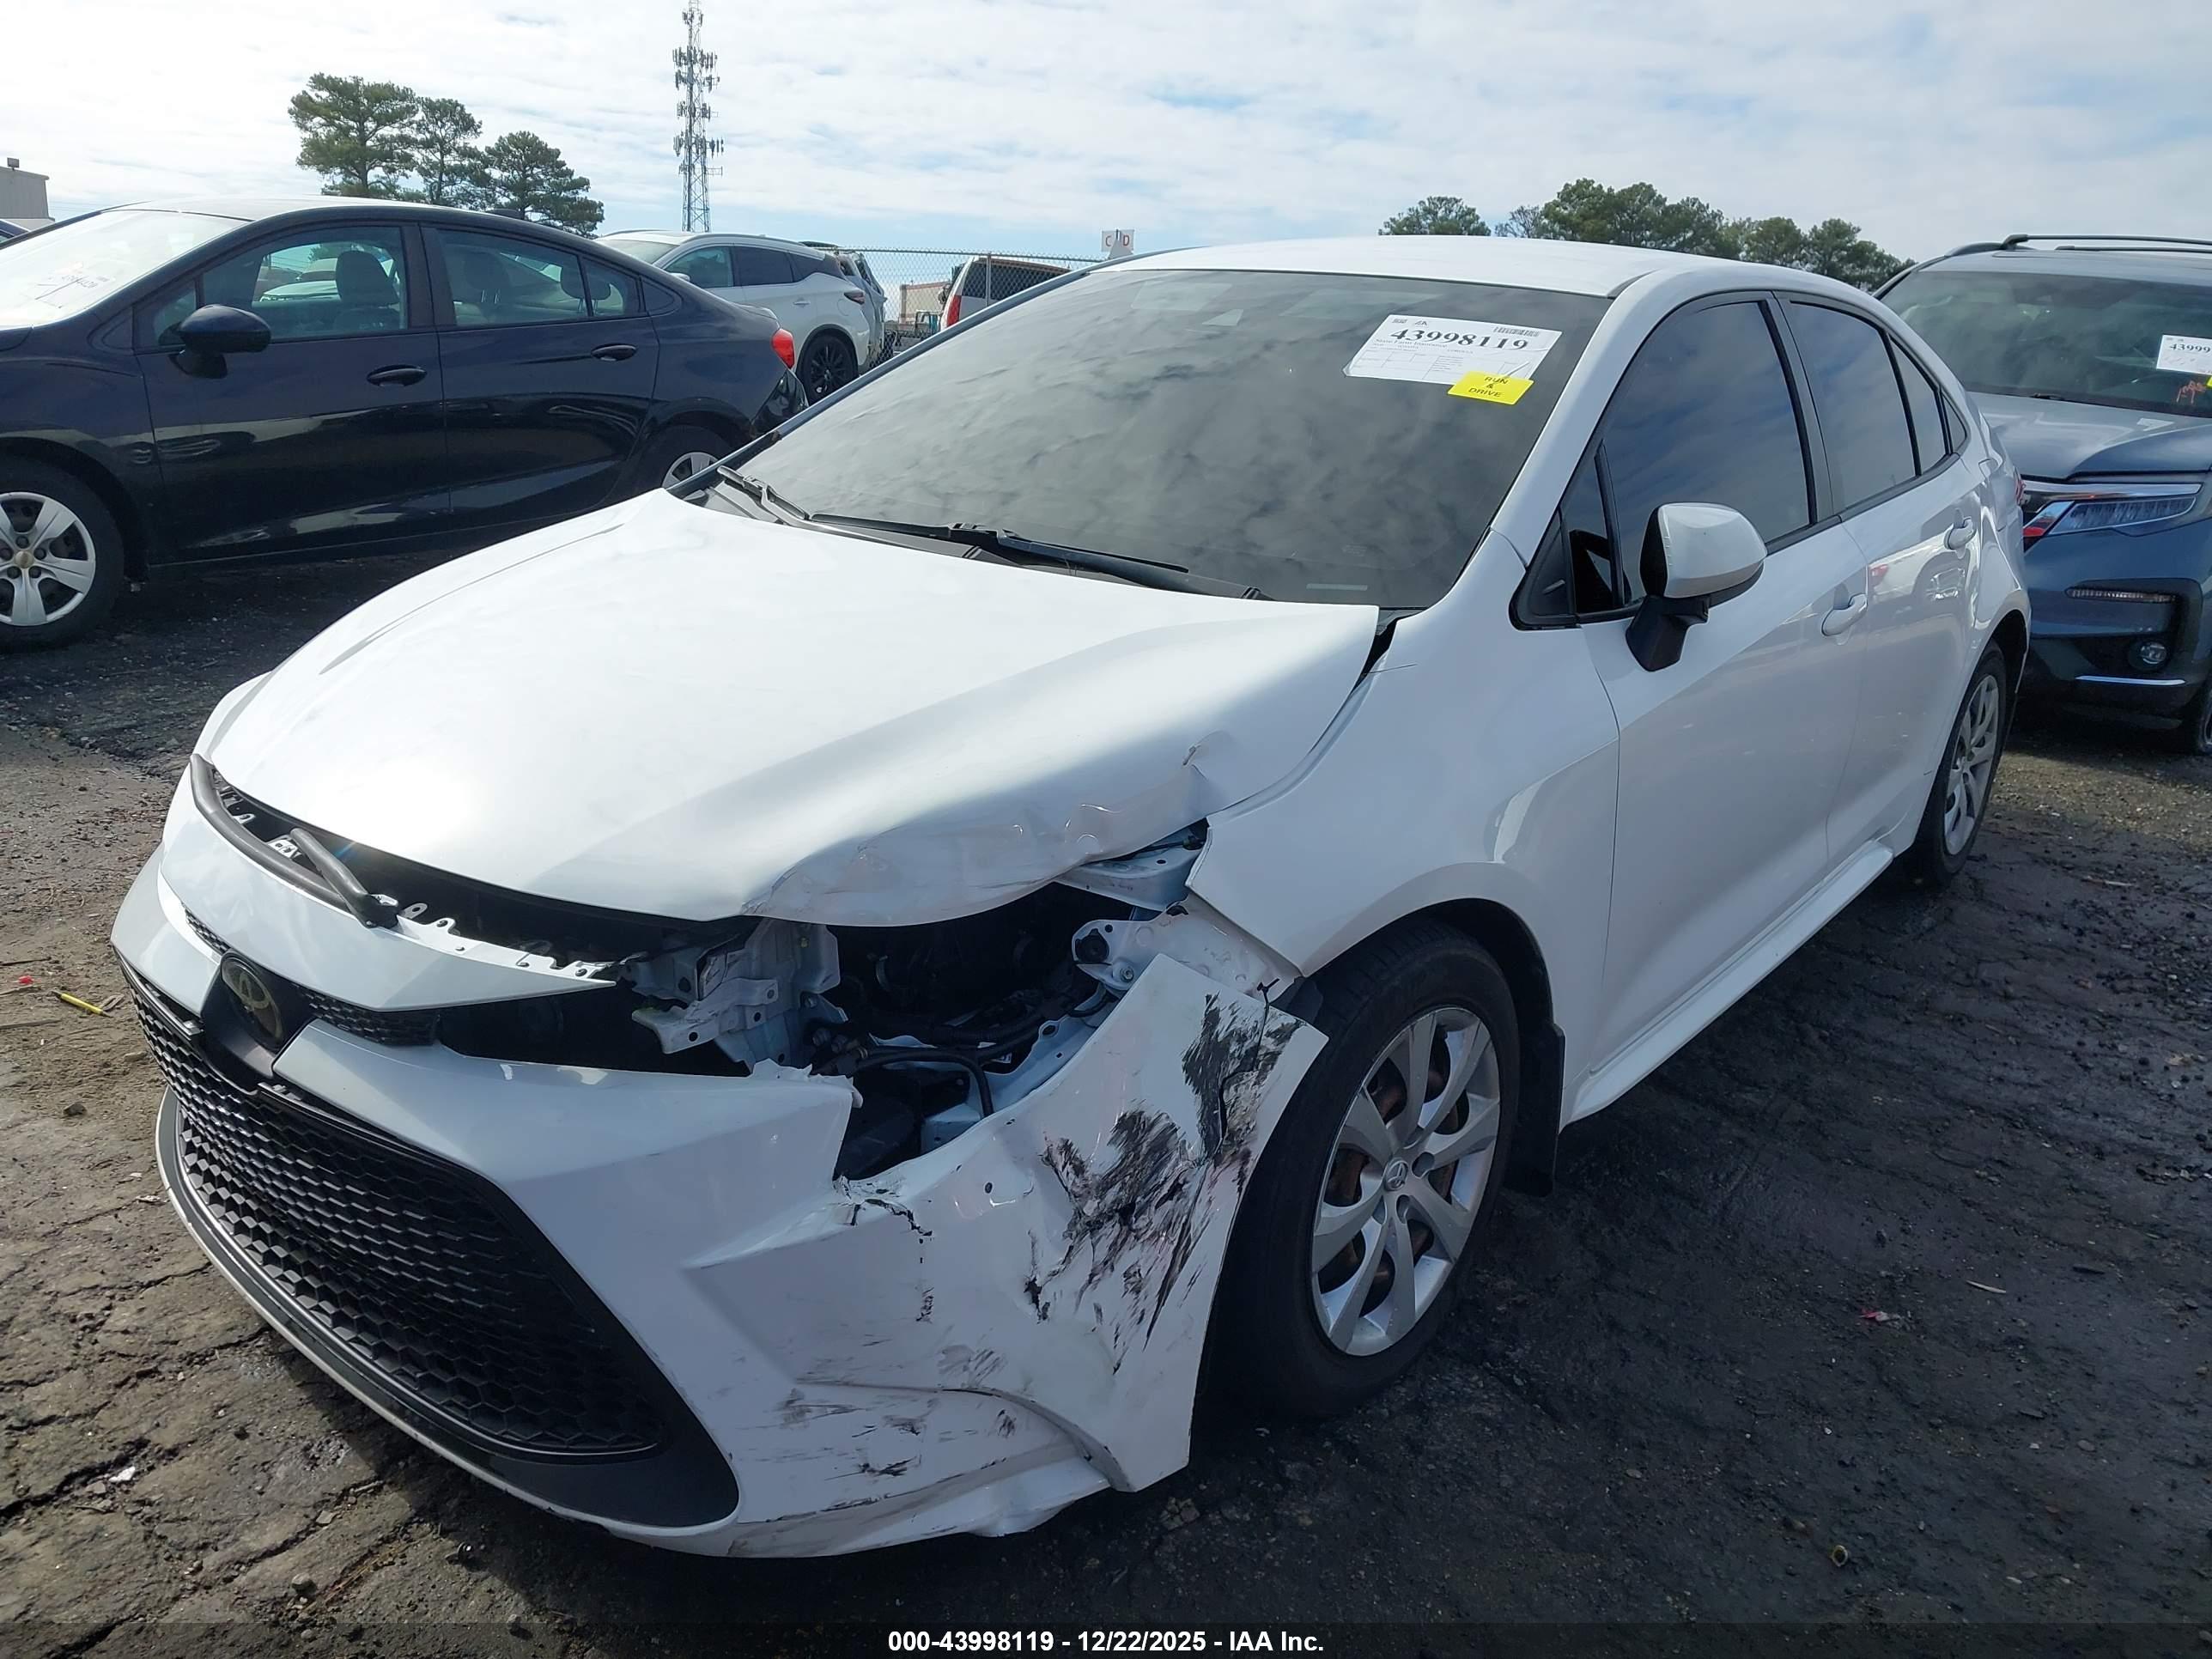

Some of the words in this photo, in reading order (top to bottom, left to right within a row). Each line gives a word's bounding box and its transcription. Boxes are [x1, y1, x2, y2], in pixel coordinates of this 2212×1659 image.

[1105, 235, 1112, 247] C
[1122, 234, 1130, 246] D
[1389, 328, 1528, 350] 43998119
[1485, 376, 1509, 385] RUN
[1468, 387, 1504, 398] DRIVE
